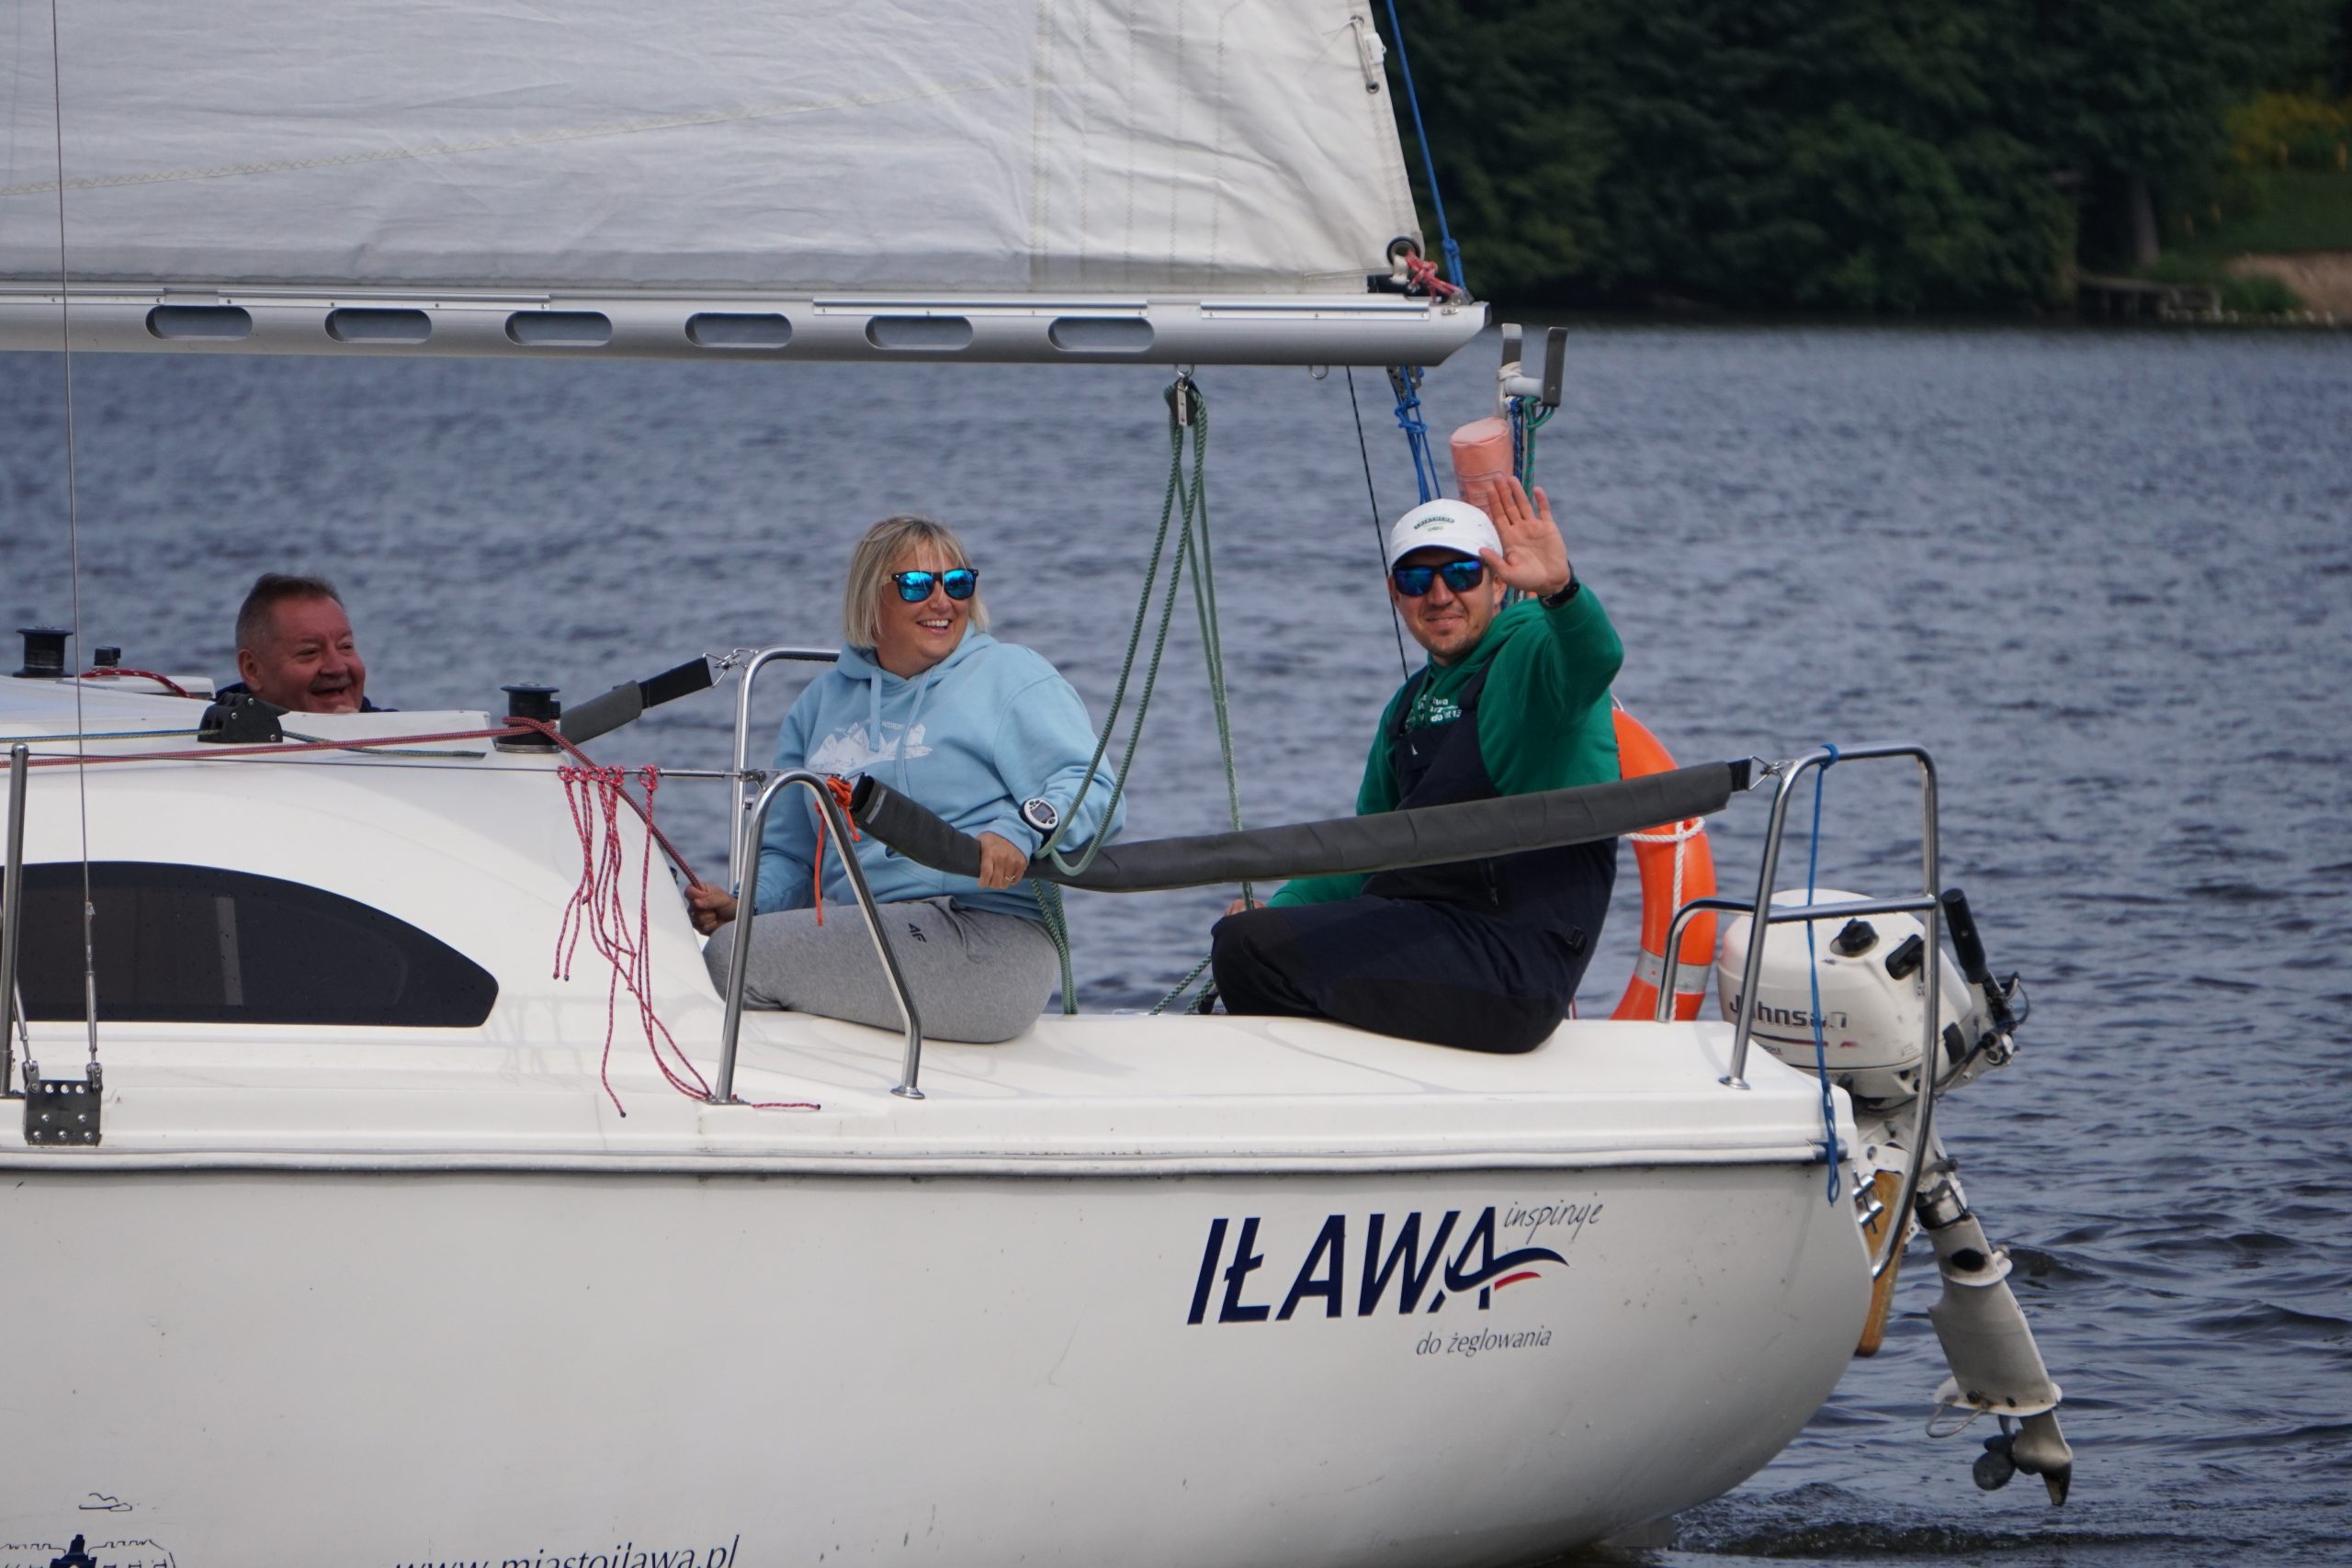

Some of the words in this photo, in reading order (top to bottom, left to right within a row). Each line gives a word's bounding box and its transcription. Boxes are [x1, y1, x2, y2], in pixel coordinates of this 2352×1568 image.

[1729, 994, 1848, 1029] Jhnsn
[1504, 1192, 1604, 1246] inspiruje
[1186, 1206, 1497, 1325] IŁAWA
[1416, 1331, 1442, 1355] do
[1446, 1325, 1552, 1358] żeglowania
[395, 1534, 741, 1568] iastoilawa.pl
